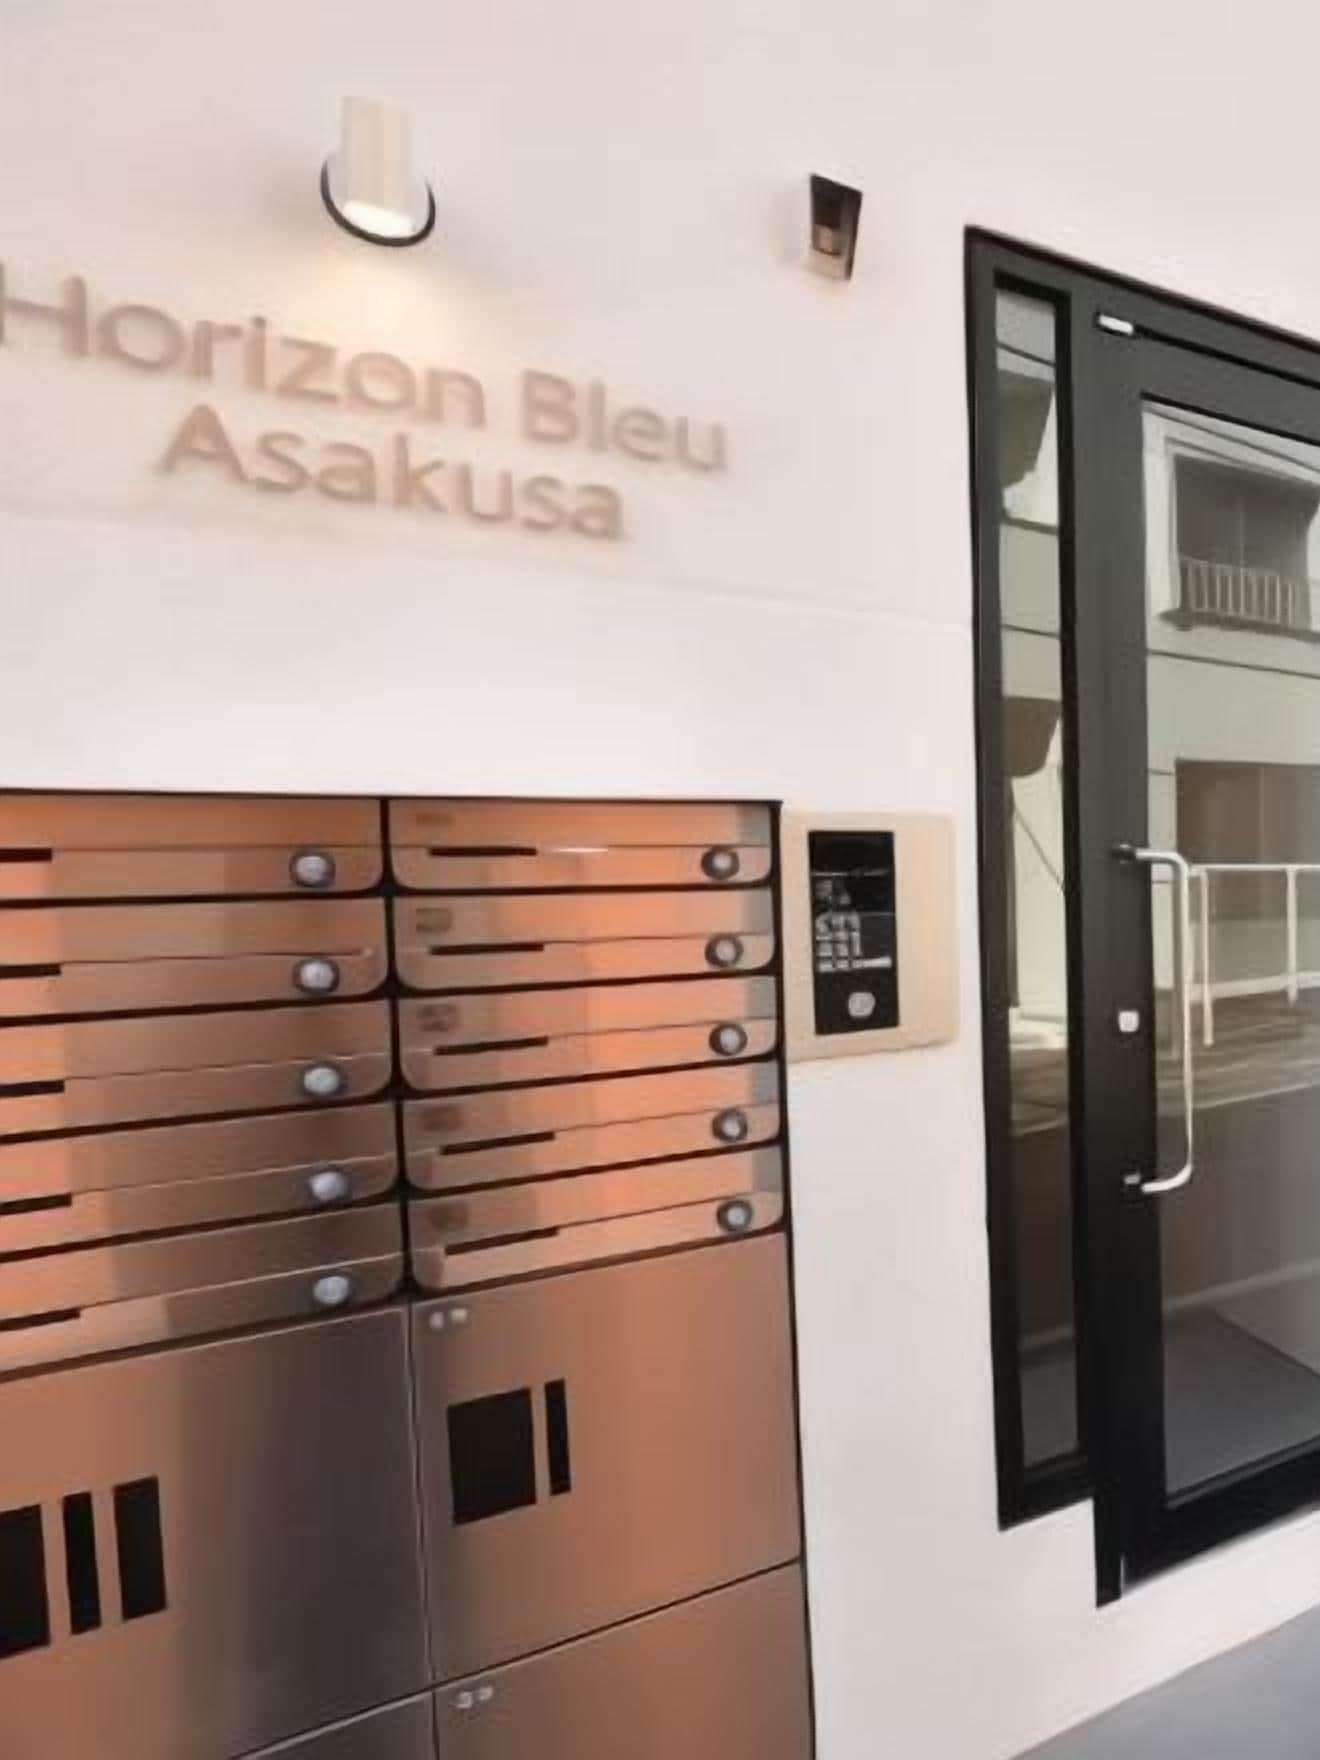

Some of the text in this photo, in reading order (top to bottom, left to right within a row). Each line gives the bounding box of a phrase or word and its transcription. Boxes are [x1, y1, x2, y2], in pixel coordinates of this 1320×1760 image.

[0, 260, 728, 473] Horizon Bleu
[158, 403, 626, 539] Asakusa
